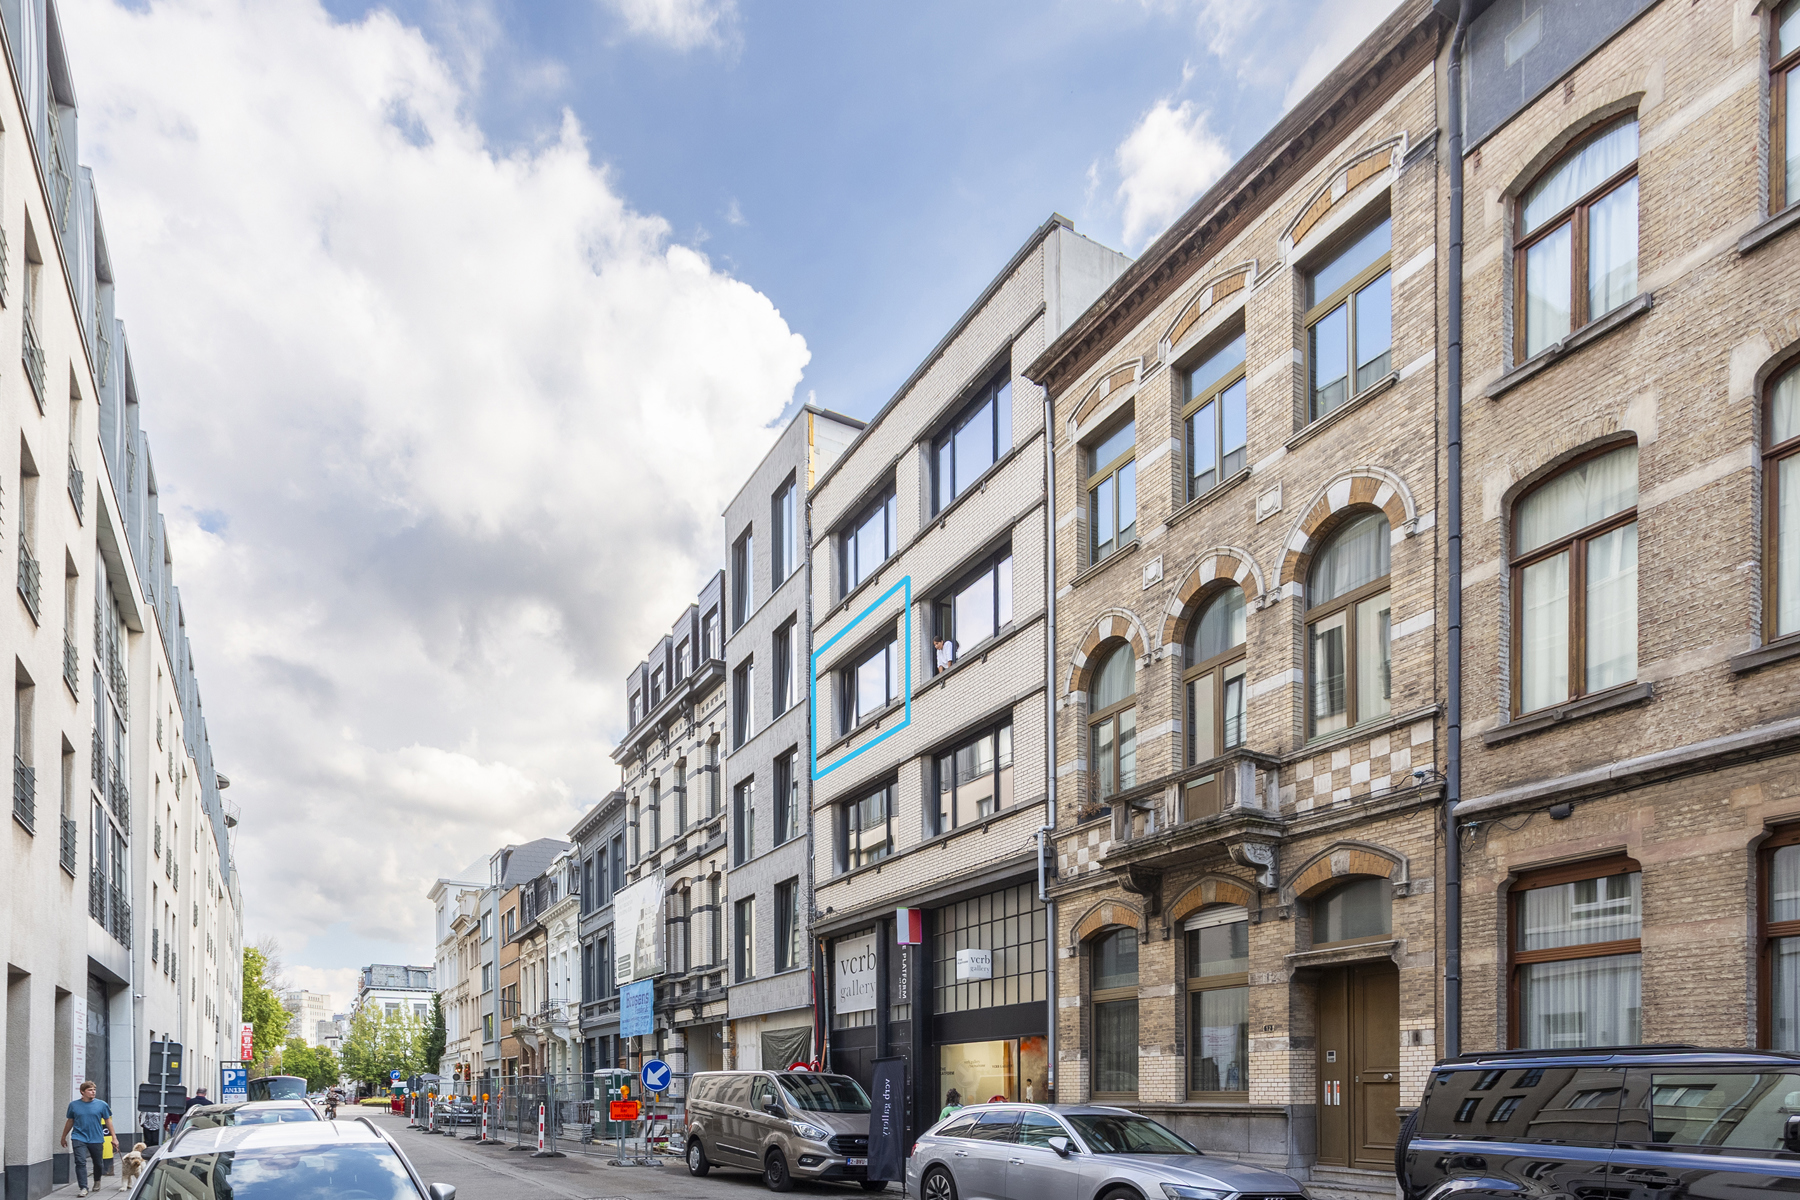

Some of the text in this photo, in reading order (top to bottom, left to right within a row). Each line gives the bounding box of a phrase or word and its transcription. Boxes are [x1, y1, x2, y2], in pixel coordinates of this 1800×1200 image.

[840, 944, 876, 975] vcrb
[970, 954, 990, 965] vcrb
[970, 965, 990, 973] gallery
[840, 979, 876, 1003] gallery
[224, 1070, 236, 1086] P
